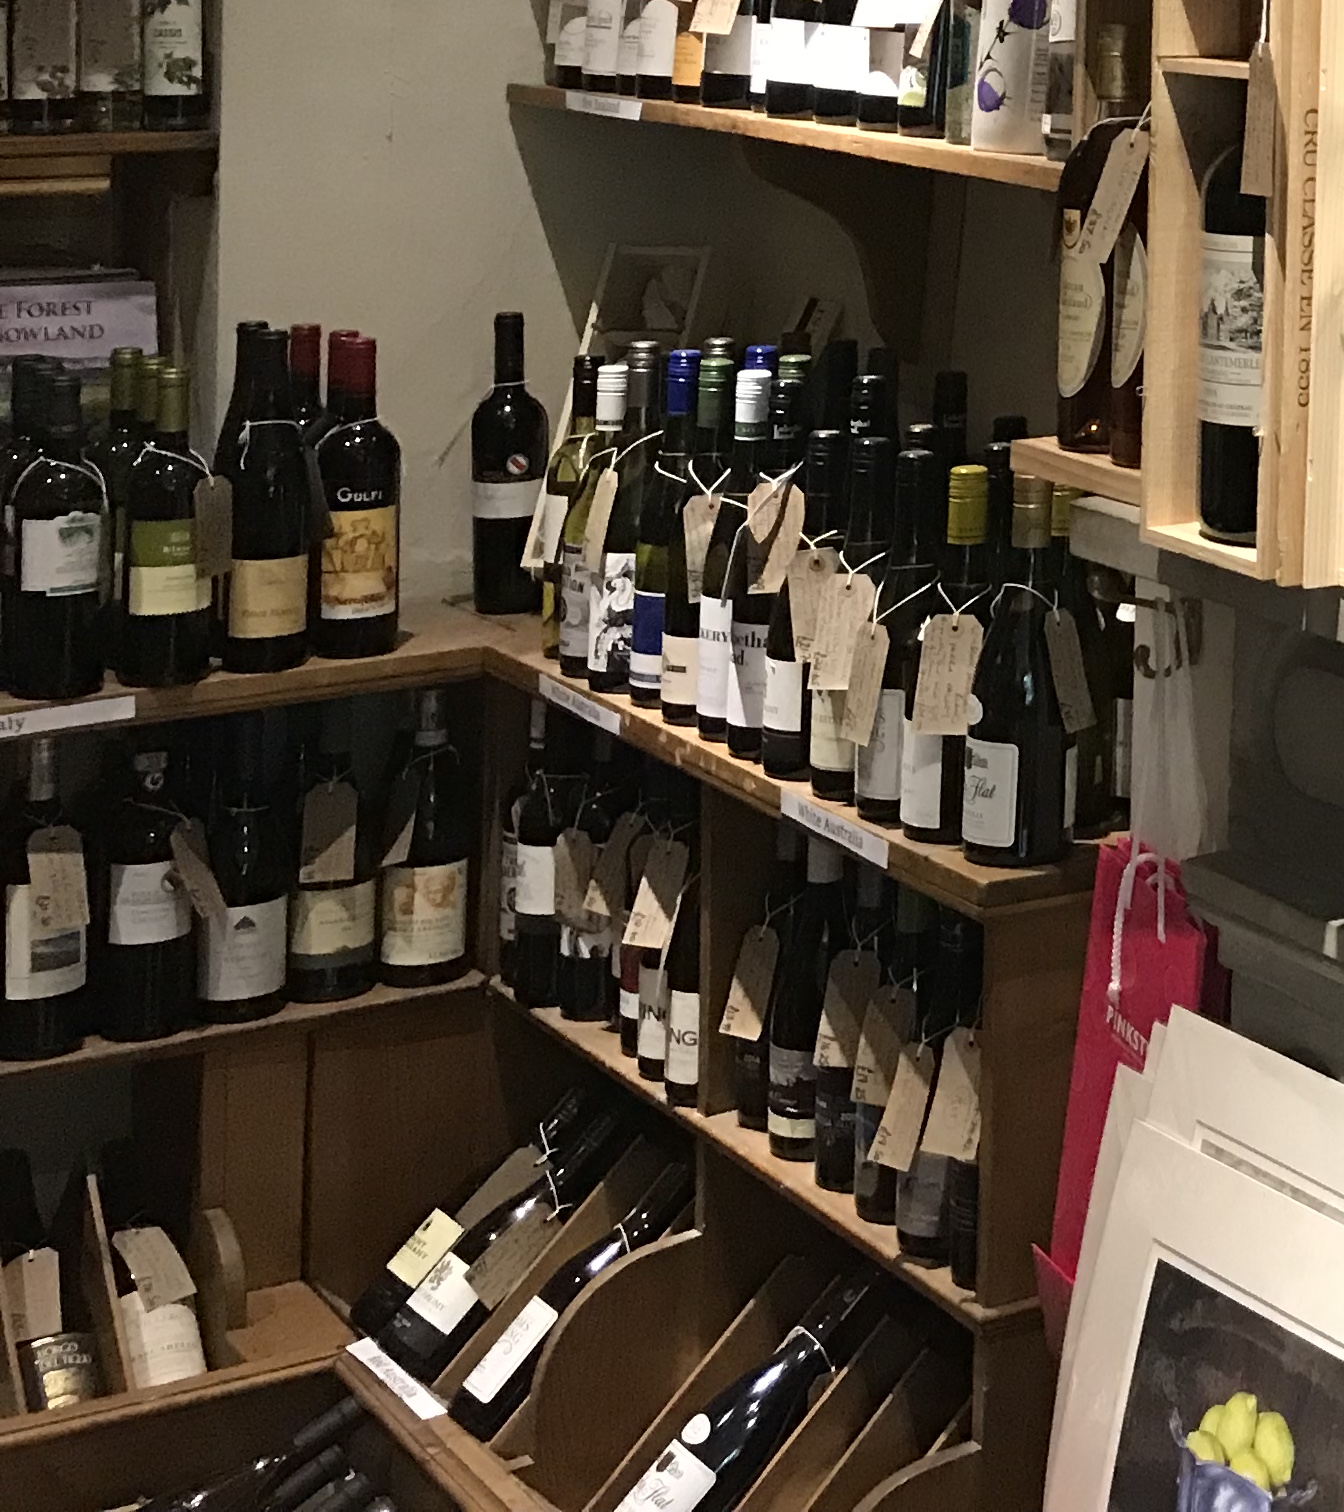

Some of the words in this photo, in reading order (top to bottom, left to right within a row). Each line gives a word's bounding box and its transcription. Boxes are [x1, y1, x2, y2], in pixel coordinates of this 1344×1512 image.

[16, 299, 94, 319] FOREST
[336, 487, 383, 503] GULFI
[1104, 1008, 1149, 1058] PINKST
